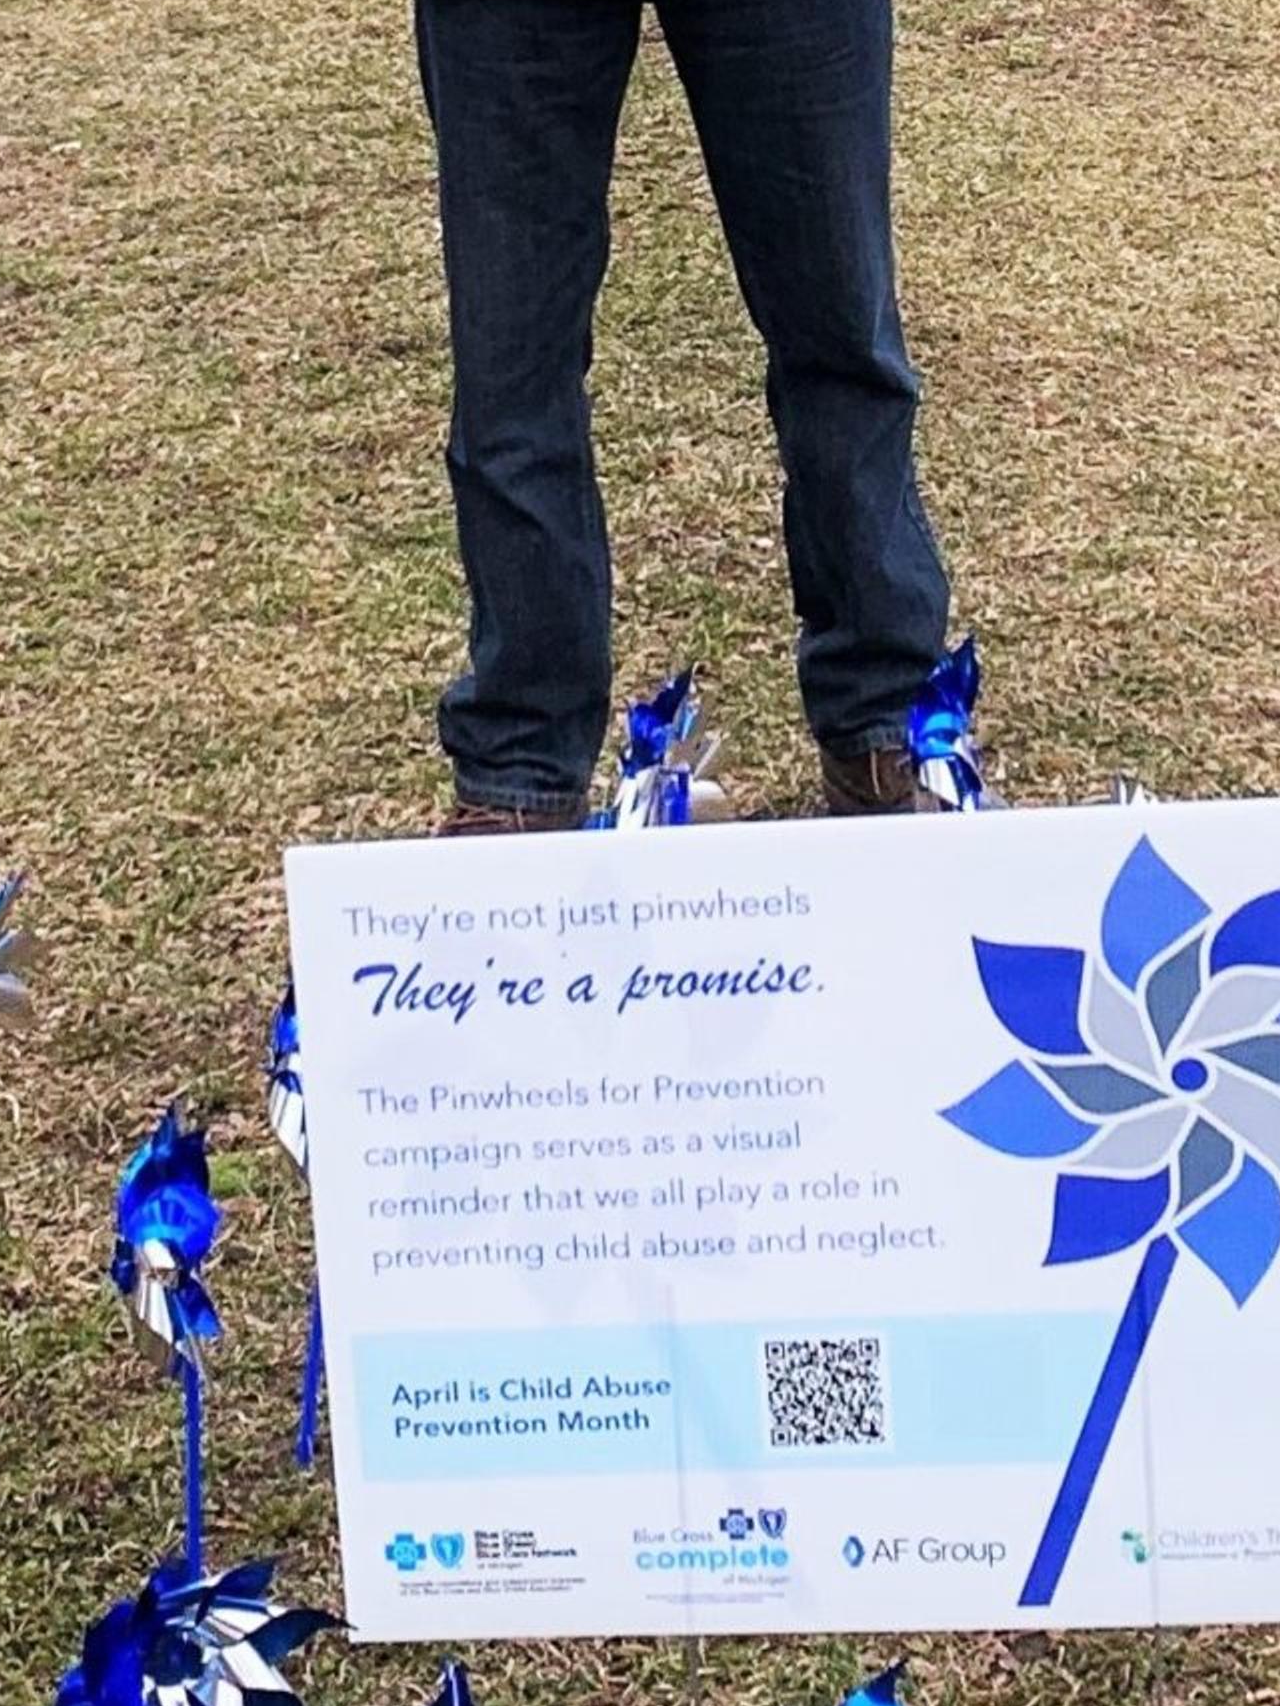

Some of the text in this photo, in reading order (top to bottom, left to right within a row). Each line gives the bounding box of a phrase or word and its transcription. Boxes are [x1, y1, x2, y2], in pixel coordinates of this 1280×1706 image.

[342, 885, 812, 941] They're not just pinwheels
[352, 957, 824, 1024] They're a promise.
[357, 1069, 824, 1114] The Pinwheels for Prevention
[364, 1121, 801, 1170] campaign serves as a visual
[369, 1171, 900, 1218] reminder that we all play a role in
[373, 1221, 945, 1276] preventing child abuse and neglect.
[392, 1374, 671, 1410] April is Child Abuse
[395, 1408, 650, 1438] Prevention Month
[633, 1527, 714, 1543] Blue Cross
[872, 1536, 1007, 1568] AF Group
[1157, 1527, 1259, 1548] Children's
[635, 1544, 789, 1573] complete
